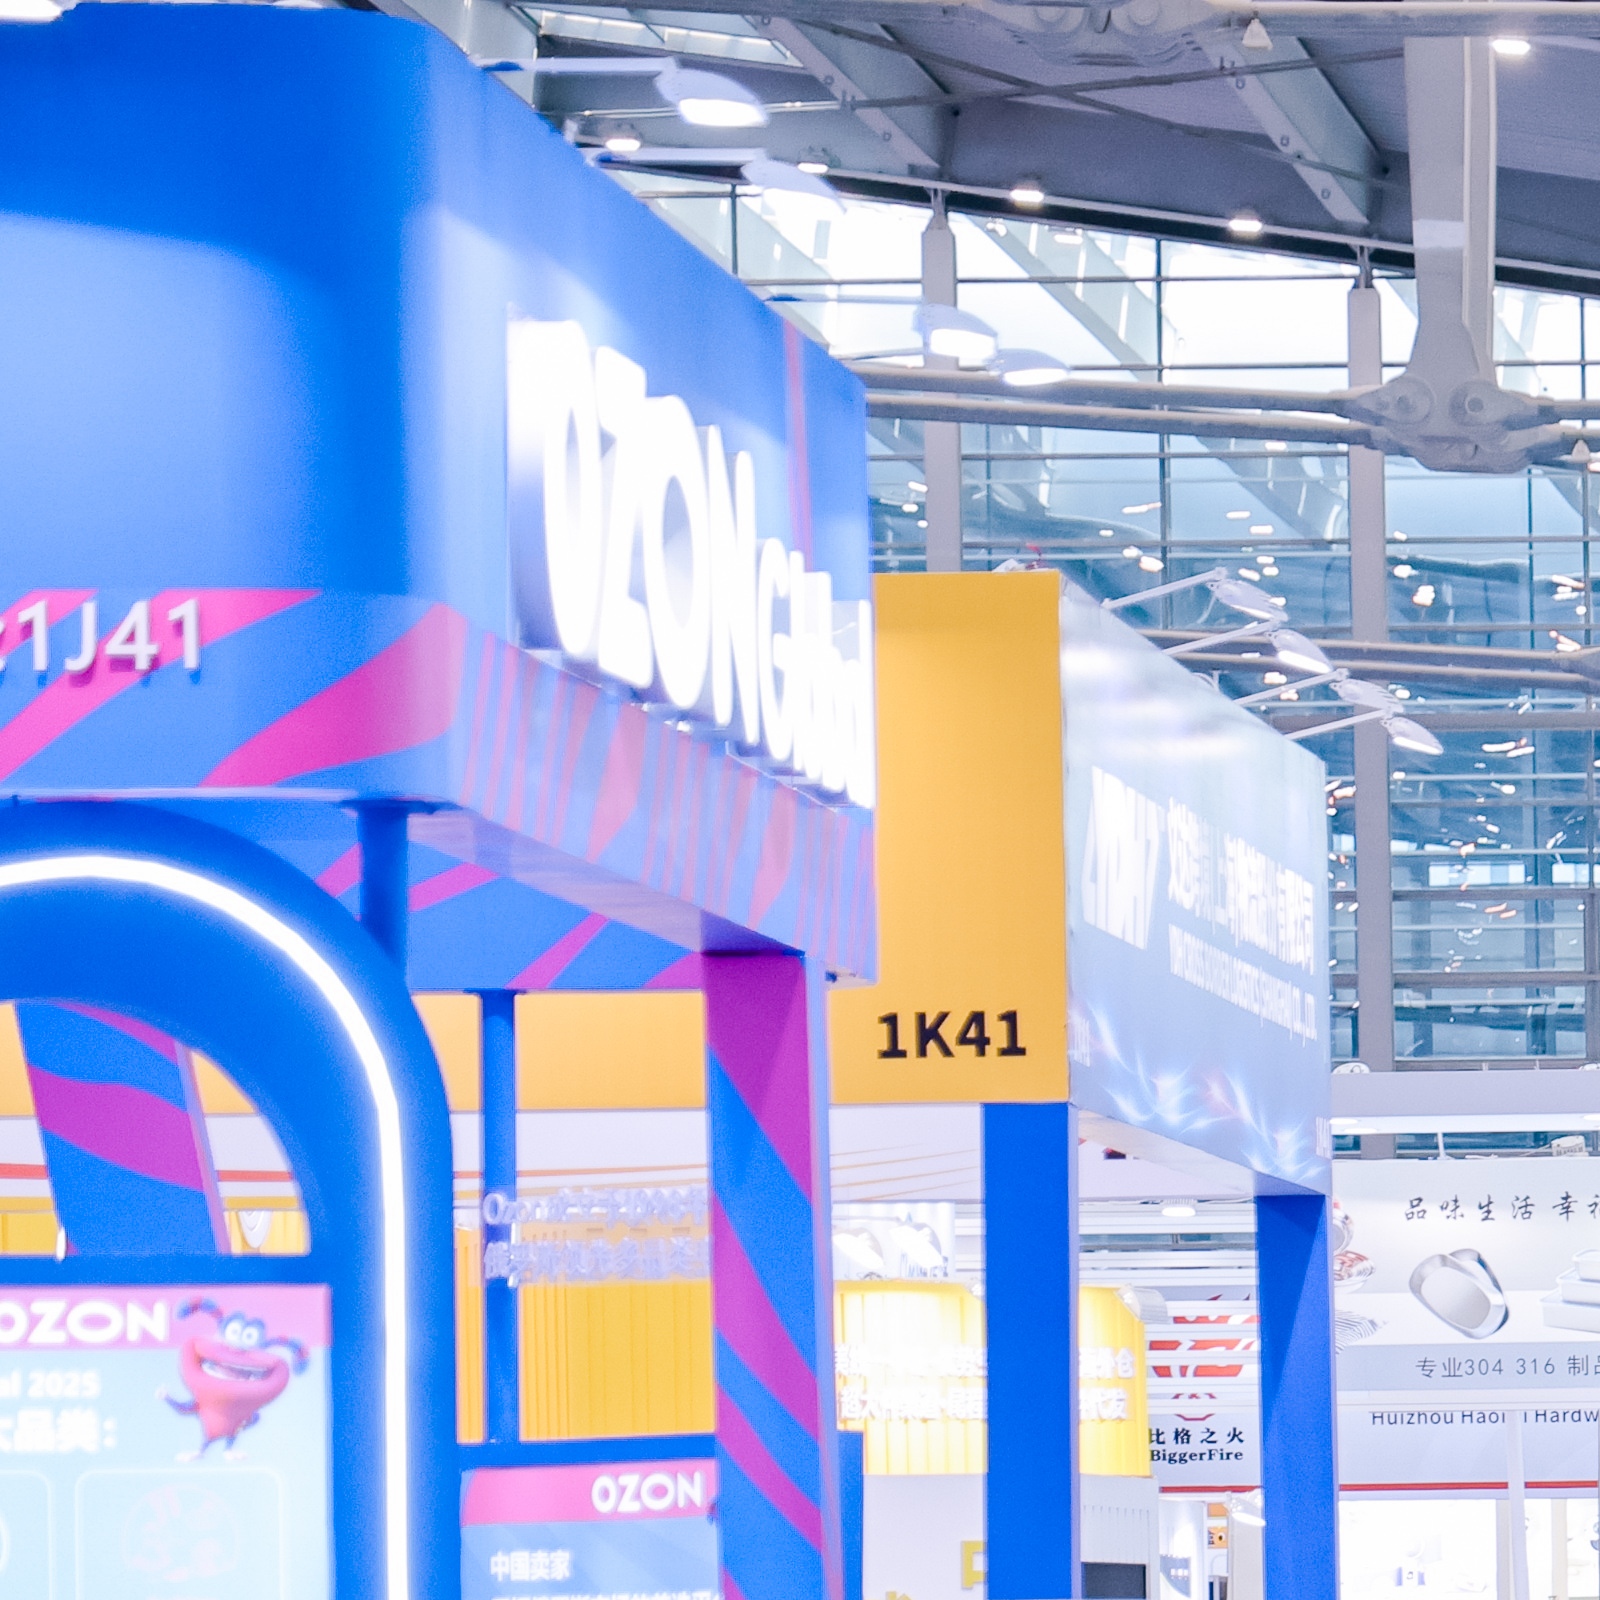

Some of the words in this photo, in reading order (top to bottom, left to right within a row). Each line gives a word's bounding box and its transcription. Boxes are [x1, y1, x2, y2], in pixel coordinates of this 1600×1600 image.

[506, 318, 760, 746] OZON
[18, 600, 200, 672] 1J41
[877, 1010, 1027, 1059] 1K41
[1404, 1193, 1535, 1222] 品味生活
[0, 1301, 167, 1344] OZON
[1415, 1356, 1504, 1379] 专业304
[1516, 1357, 1555, 1376] 316
[1372, 1410, 1453, 1426] Huizhou
[1149, 1427, 1245, 1445] 比格之火
[1149, 1447, 1243, 1463] BiggerFire
[591, 1470, 703, 1514] OZON
[490, 1550, 571, 1582] 中国卖家
